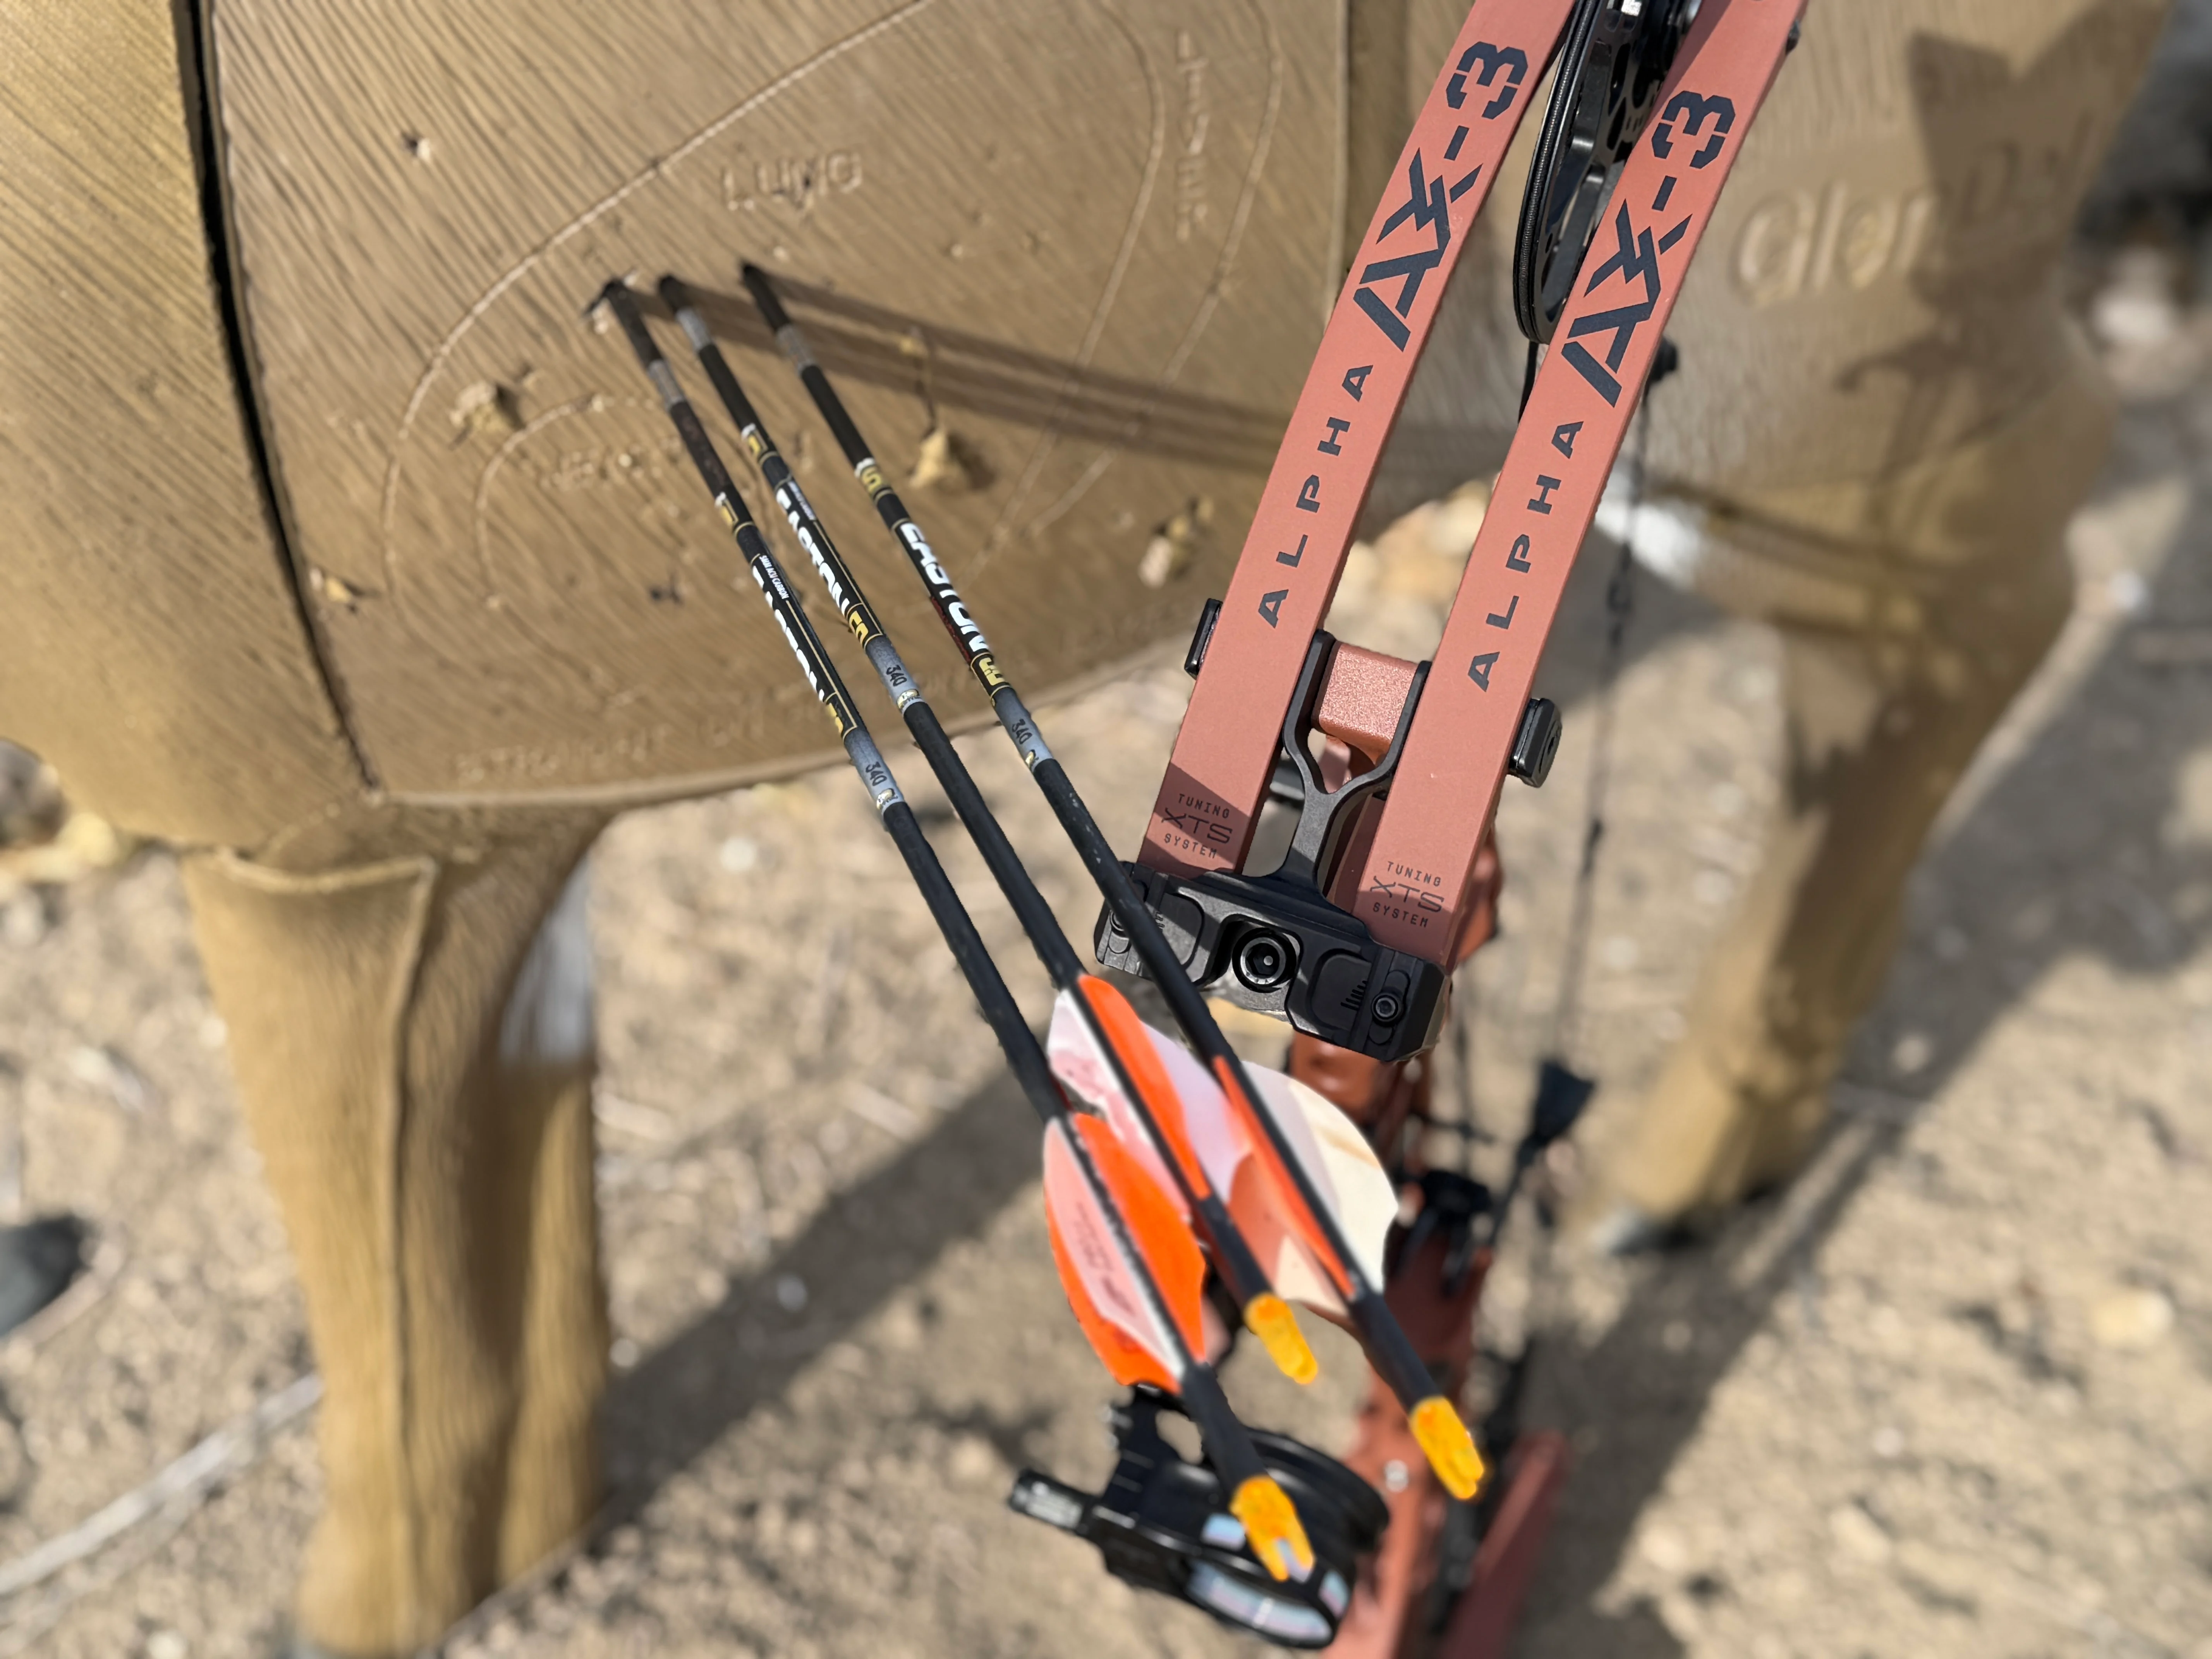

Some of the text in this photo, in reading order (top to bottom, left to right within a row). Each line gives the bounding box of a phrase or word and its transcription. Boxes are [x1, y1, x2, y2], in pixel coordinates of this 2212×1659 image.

[1258, 365, 1373, 628] ALPHA
[1468, 421, 1583, 692] ALPHA
[772, 578, 789, 599] CARBON
[900, 522, 990, 653] EASTON
[1012, 719, 1032, 744] 340
[886, 665, 907, 687] 340
[866, 761, 887, 786] 340
[1178, 793, 1230, 818] TUNING
[1161, 807, 1233, 843] XTS
[1164, 833, 1217, 859] SYSTEM
[1388, 861, 1441, 886] TUNING
[1370, 876, 1444, 912] XTS
[1373, 902, 1428, 927] SYSTEM
